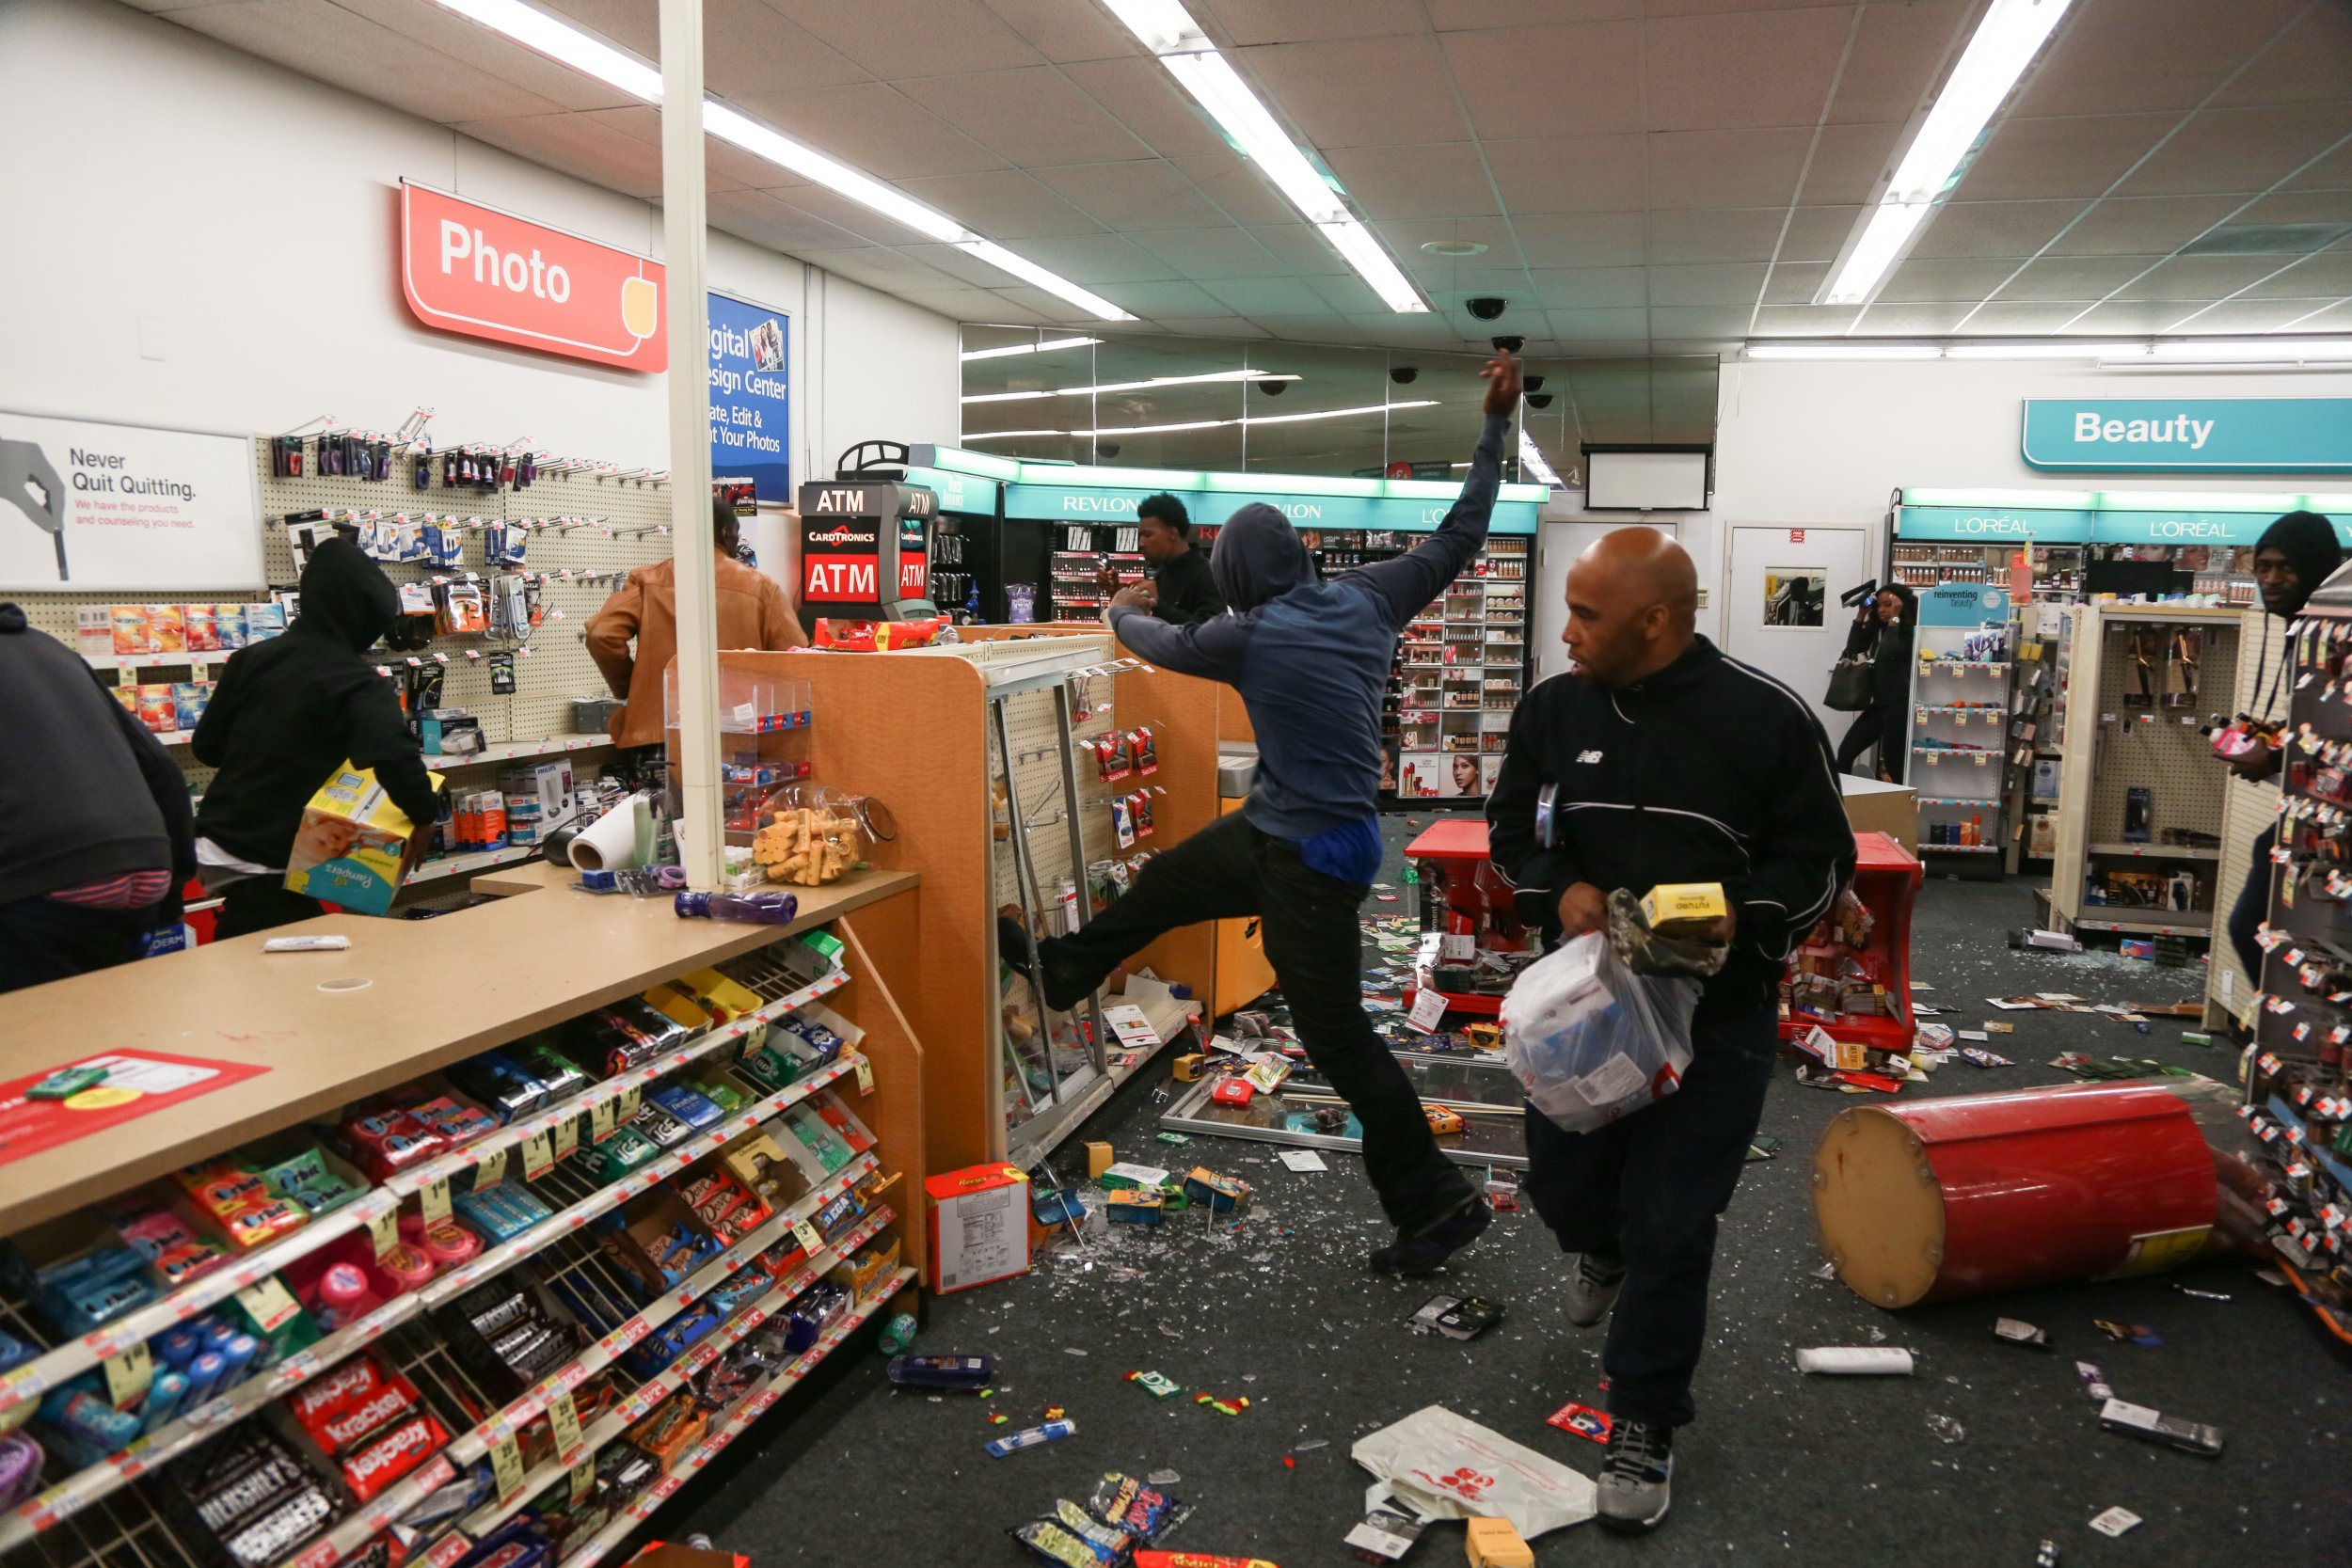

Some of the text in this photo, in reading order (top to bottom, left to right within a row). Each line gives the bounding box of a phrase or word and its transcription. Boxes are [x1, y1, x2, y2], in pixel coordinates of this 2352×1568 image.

[440, 218, 570, 304] Photo
[707, 319, 750, 360] igital
[708, 363, 787, 400] esign Center
[709, 404, 763, 429] ate, Edit &
[720, 425, 743, 447] Your
[746, 430, 781, 452] Photos
[2074, 412, 2215, 450] Beauty
[70, 448, 126, 469] Never
[72, 472, 197, 501] Quit Quitting.
[75, 499, 179, 515] We have the products
[817, 490, 864, 512] ATM
[909, 492, 930, 515] ATM
[1063, 496, 1139, 512] REVLON
[75, 515, 196, 530] and counseling you need.
[1954, 515, 2032, 533] L'ORÉAL
[2150, 519, 2235, 537] L'ORÉAL
[808, 531, 875, 543] CARDTRONICS
[808, 563, 875, 594] ATM
[900, 563, 925, 587] ATM
[1933, 589, 1978, 602] reinventing
[1950, 598, 1975, 610] beauty
[537, 765, 557, 775] PHILIPS
[325, 863, 373, 888] Pampers
[632, 1101, 656, 1125] ICE
[654, 1117, 678, 1141] ICE
[616, 1135, 642, 1161] ICE
[325, 1387, 407, 1442] krackel
[351, 1420, 431, 1482] krackel
